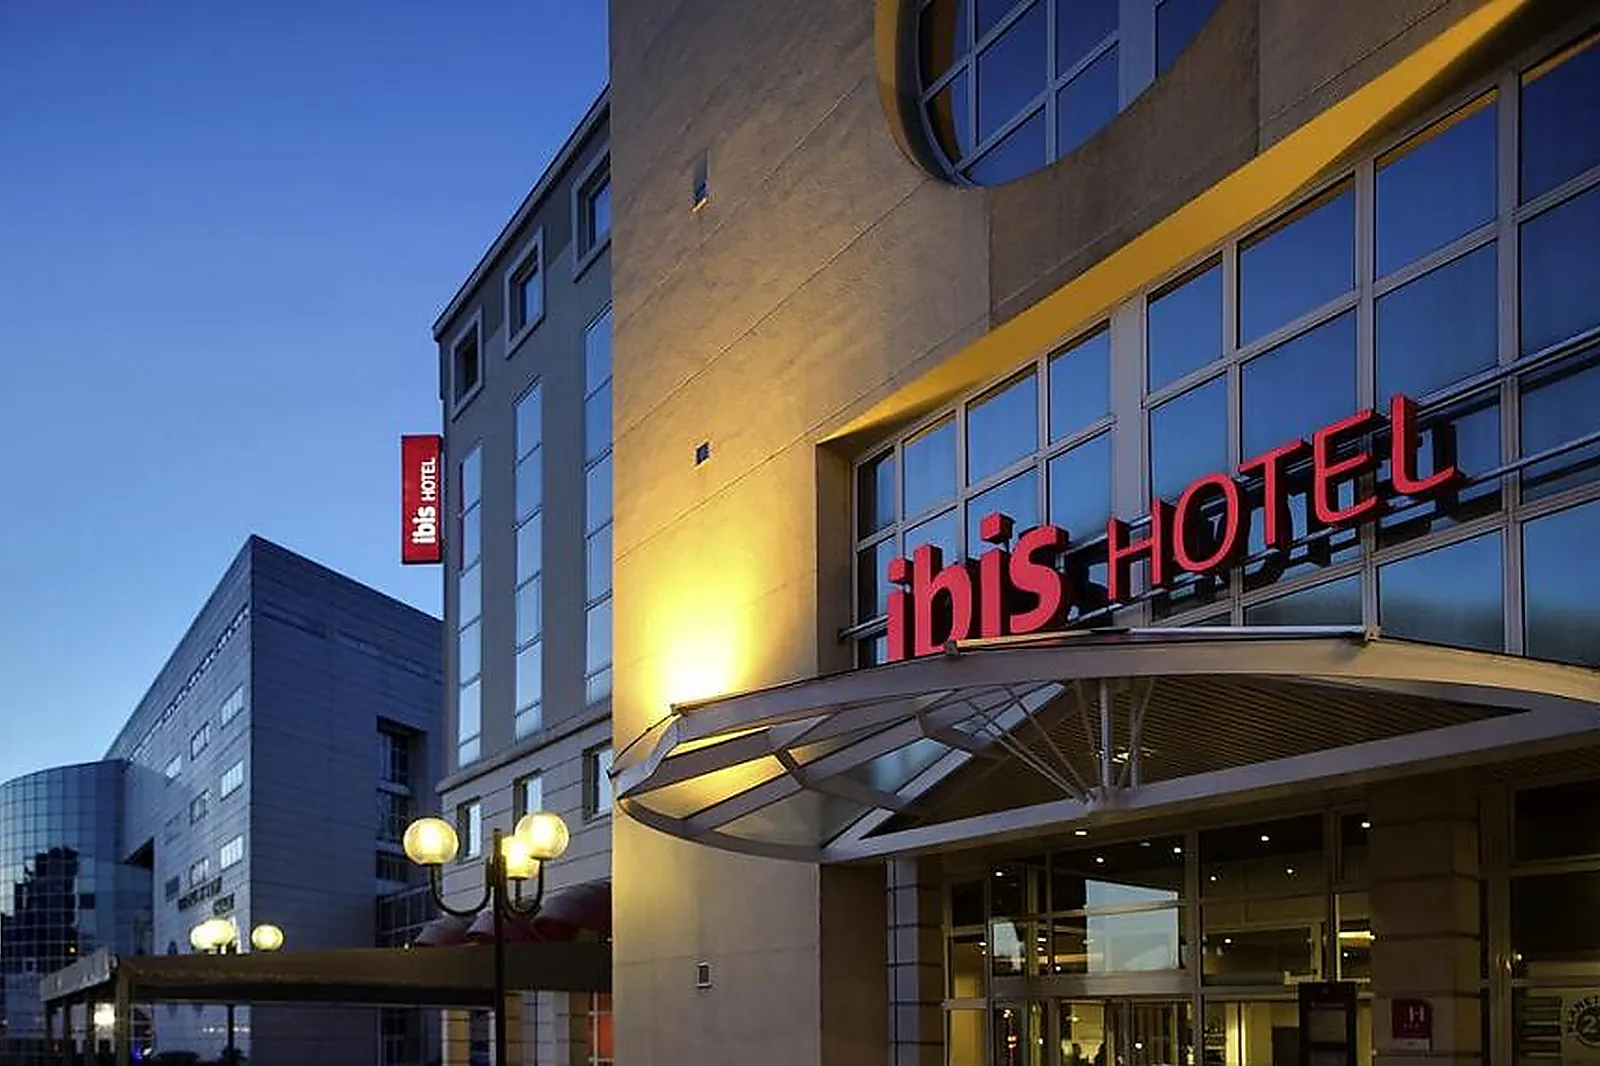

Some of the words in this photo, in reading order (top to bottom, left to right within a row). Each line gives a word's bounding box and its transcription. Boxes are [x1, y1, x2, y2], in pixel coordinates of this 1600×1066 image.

[420, 457, 436, 501] HOTEL
[412, 506, 436, 544] ibis
[887, 511, 1066, 663] ibis
[1108, 394, 1455, 601] HOTEL
